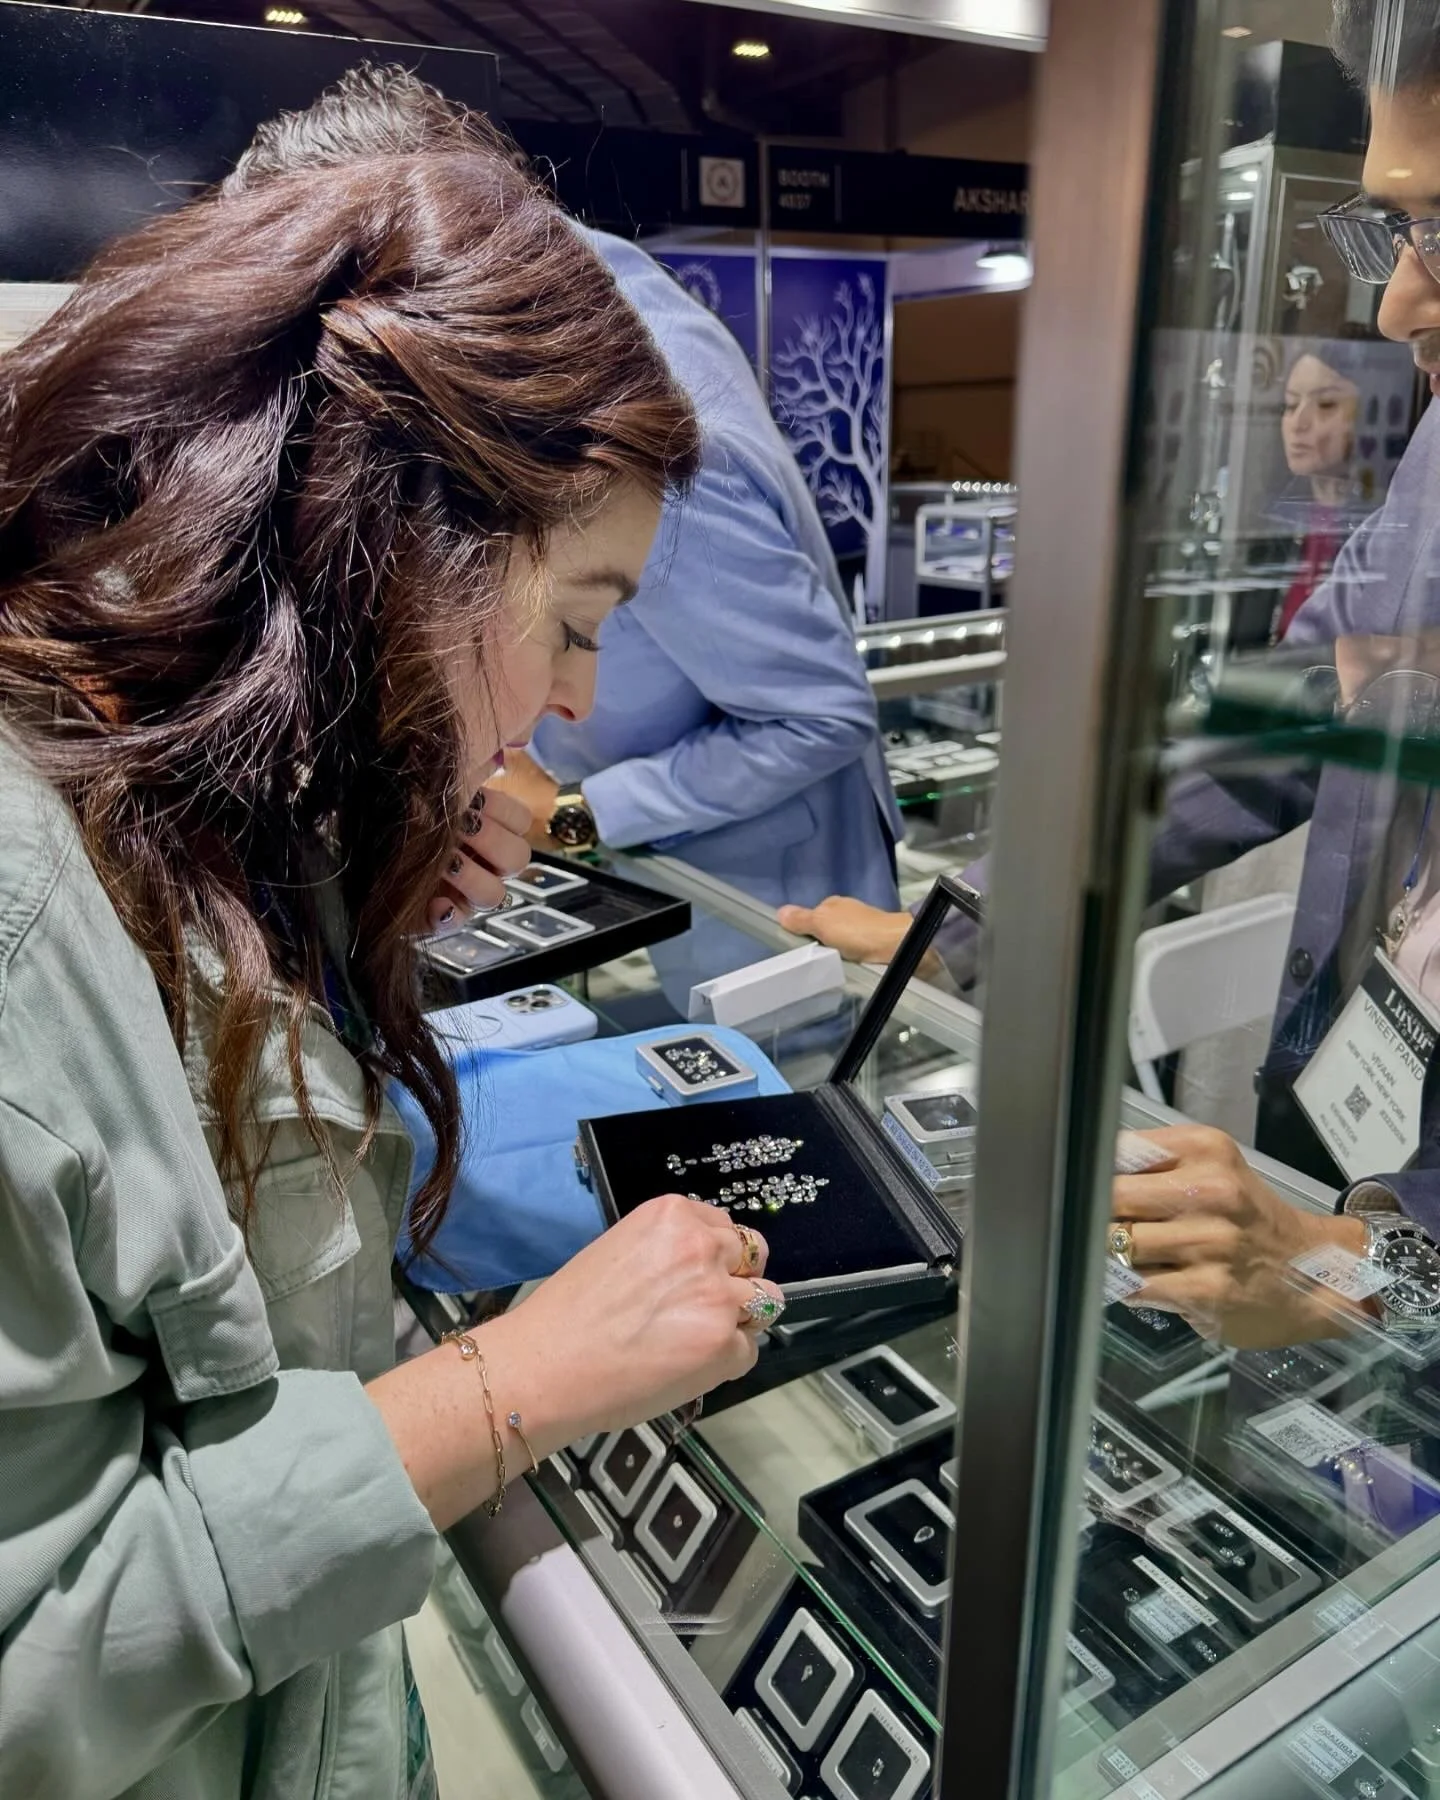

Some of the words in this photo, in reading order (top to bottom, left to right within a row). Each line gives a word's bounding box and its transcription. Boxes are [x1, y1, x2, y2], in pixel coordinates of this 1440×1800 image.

[778, 169, 830, 187] BOOTH
[1363, 999, 1397, 1043] VINEET
[1384, 988, 1435, 1057] Luxur
[1371, 1051, 1395, 1087] VIVAAN
[1374, 1079, 1389, 1099] NEW
[1388, 1099, 1405, 1122] YORK
